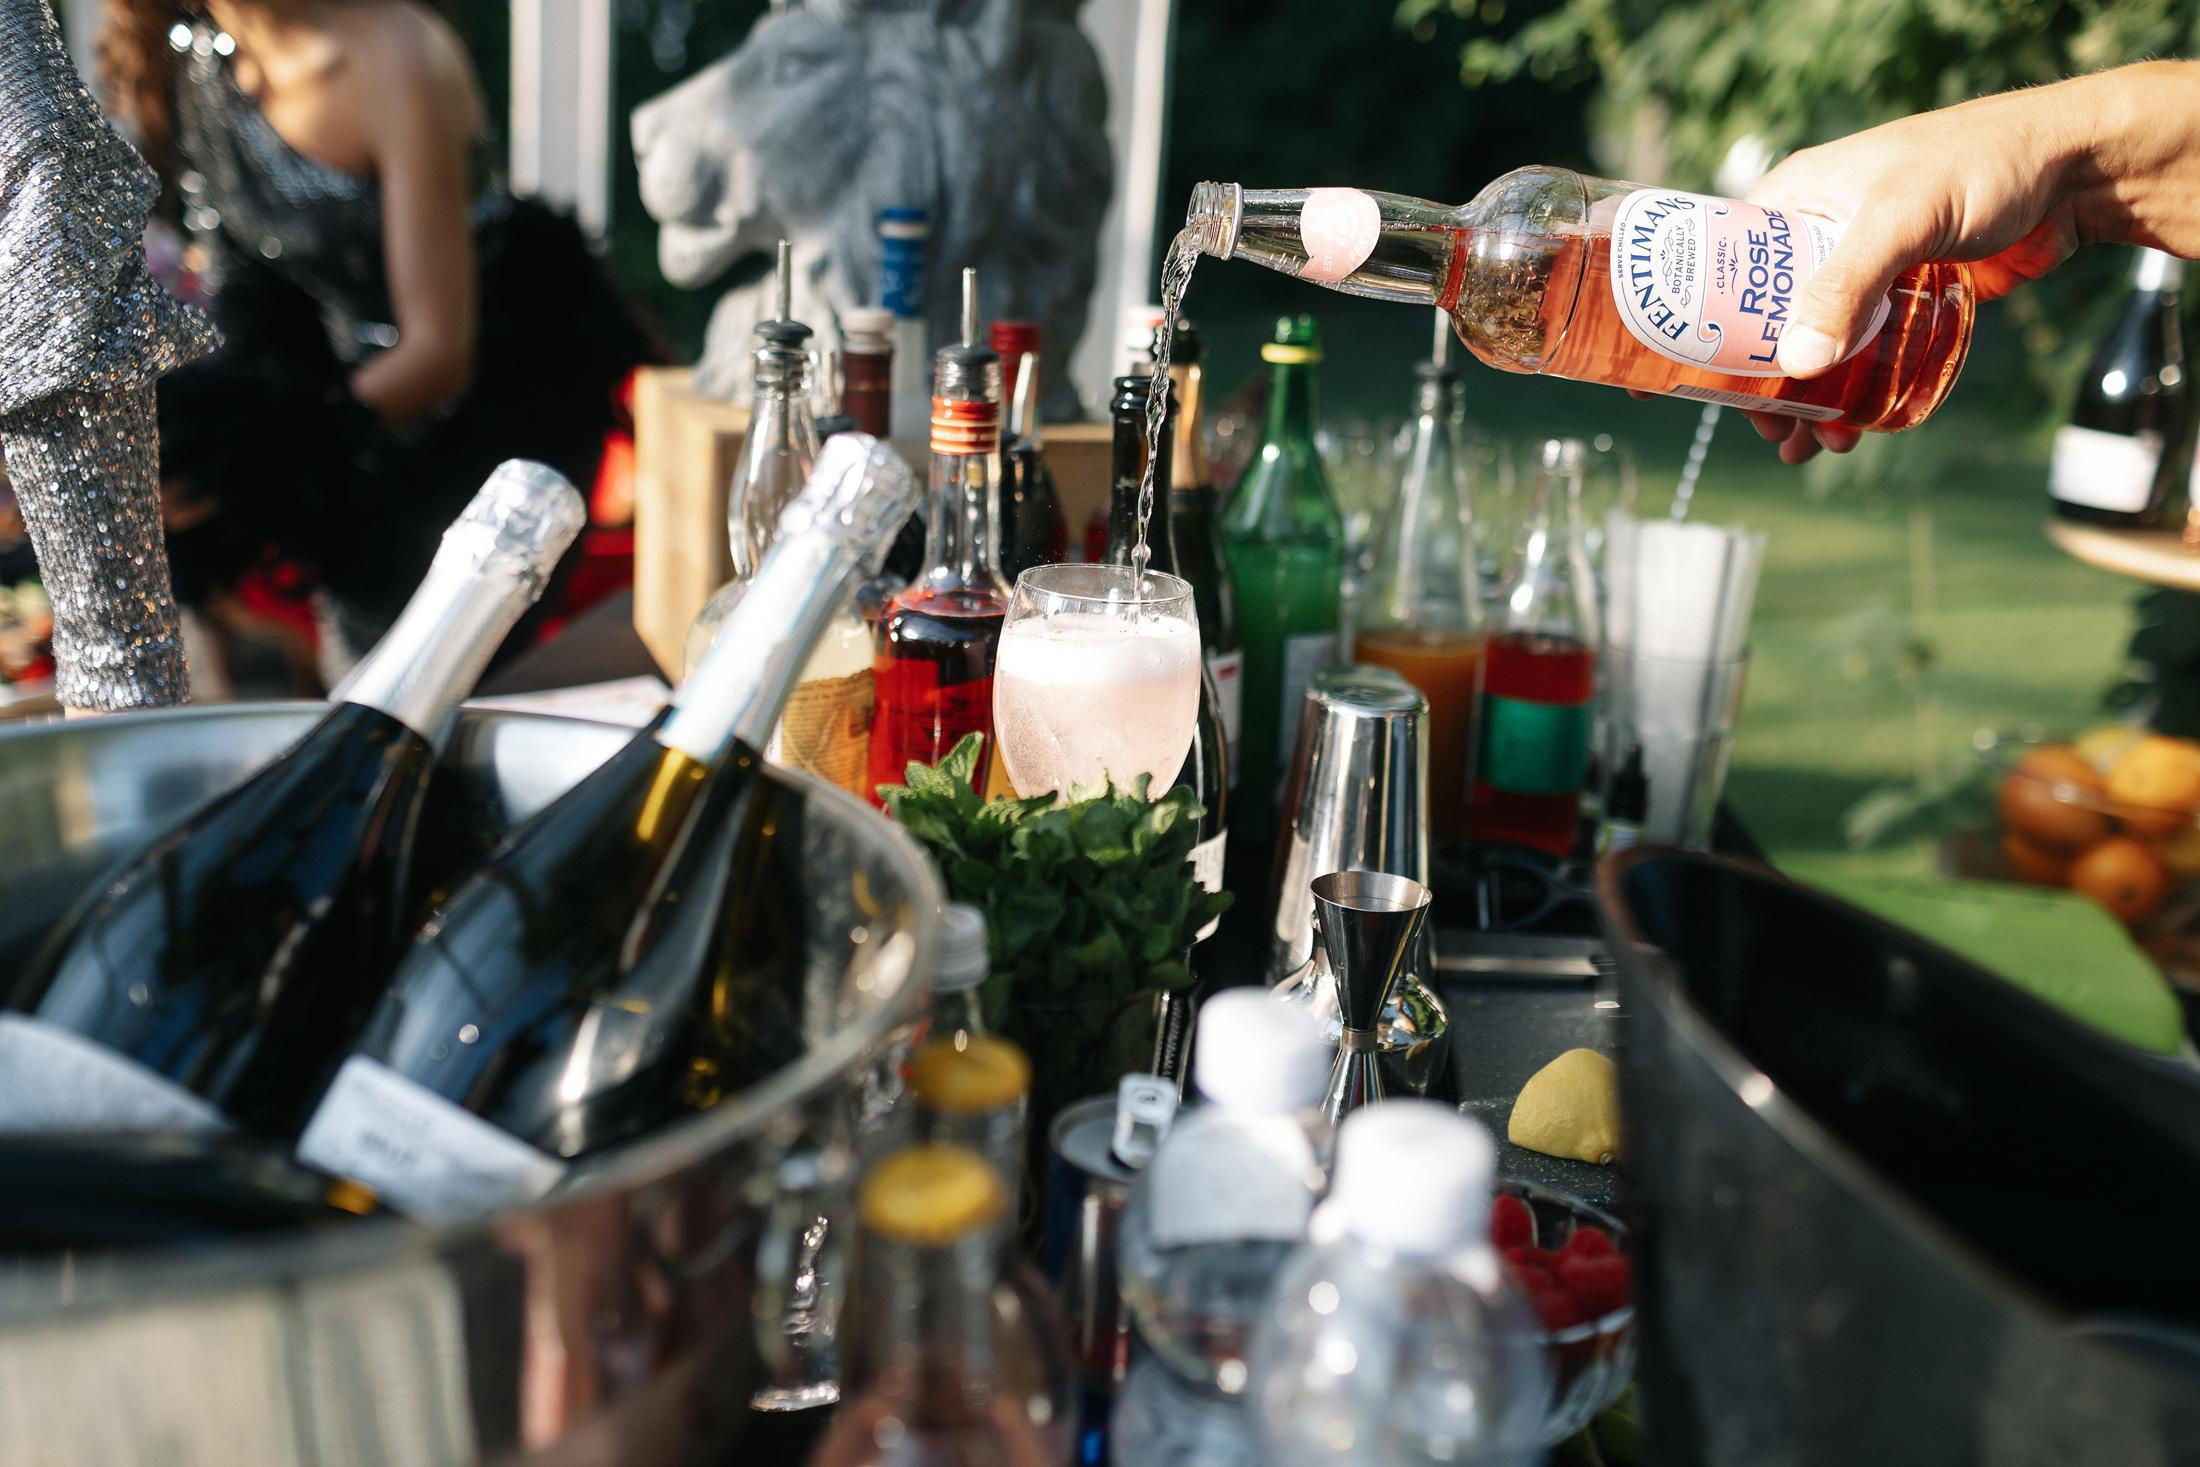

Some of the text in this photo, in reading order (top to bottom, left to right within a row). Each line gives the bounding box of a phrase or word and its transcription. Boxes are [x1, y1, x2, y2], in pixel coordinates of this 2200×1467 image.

[1618, 222, 1626, 253] CHILLED
[1631, 197, 1696, 341] FENTIMANS
[1672, 226, 1686, 294] BOTANICALLY
[1685, 239, 1696, 282] BREWED
[1739, 229, 1770, 315] ROSE
[1749, 207, 1793, 363] LEMONADE
